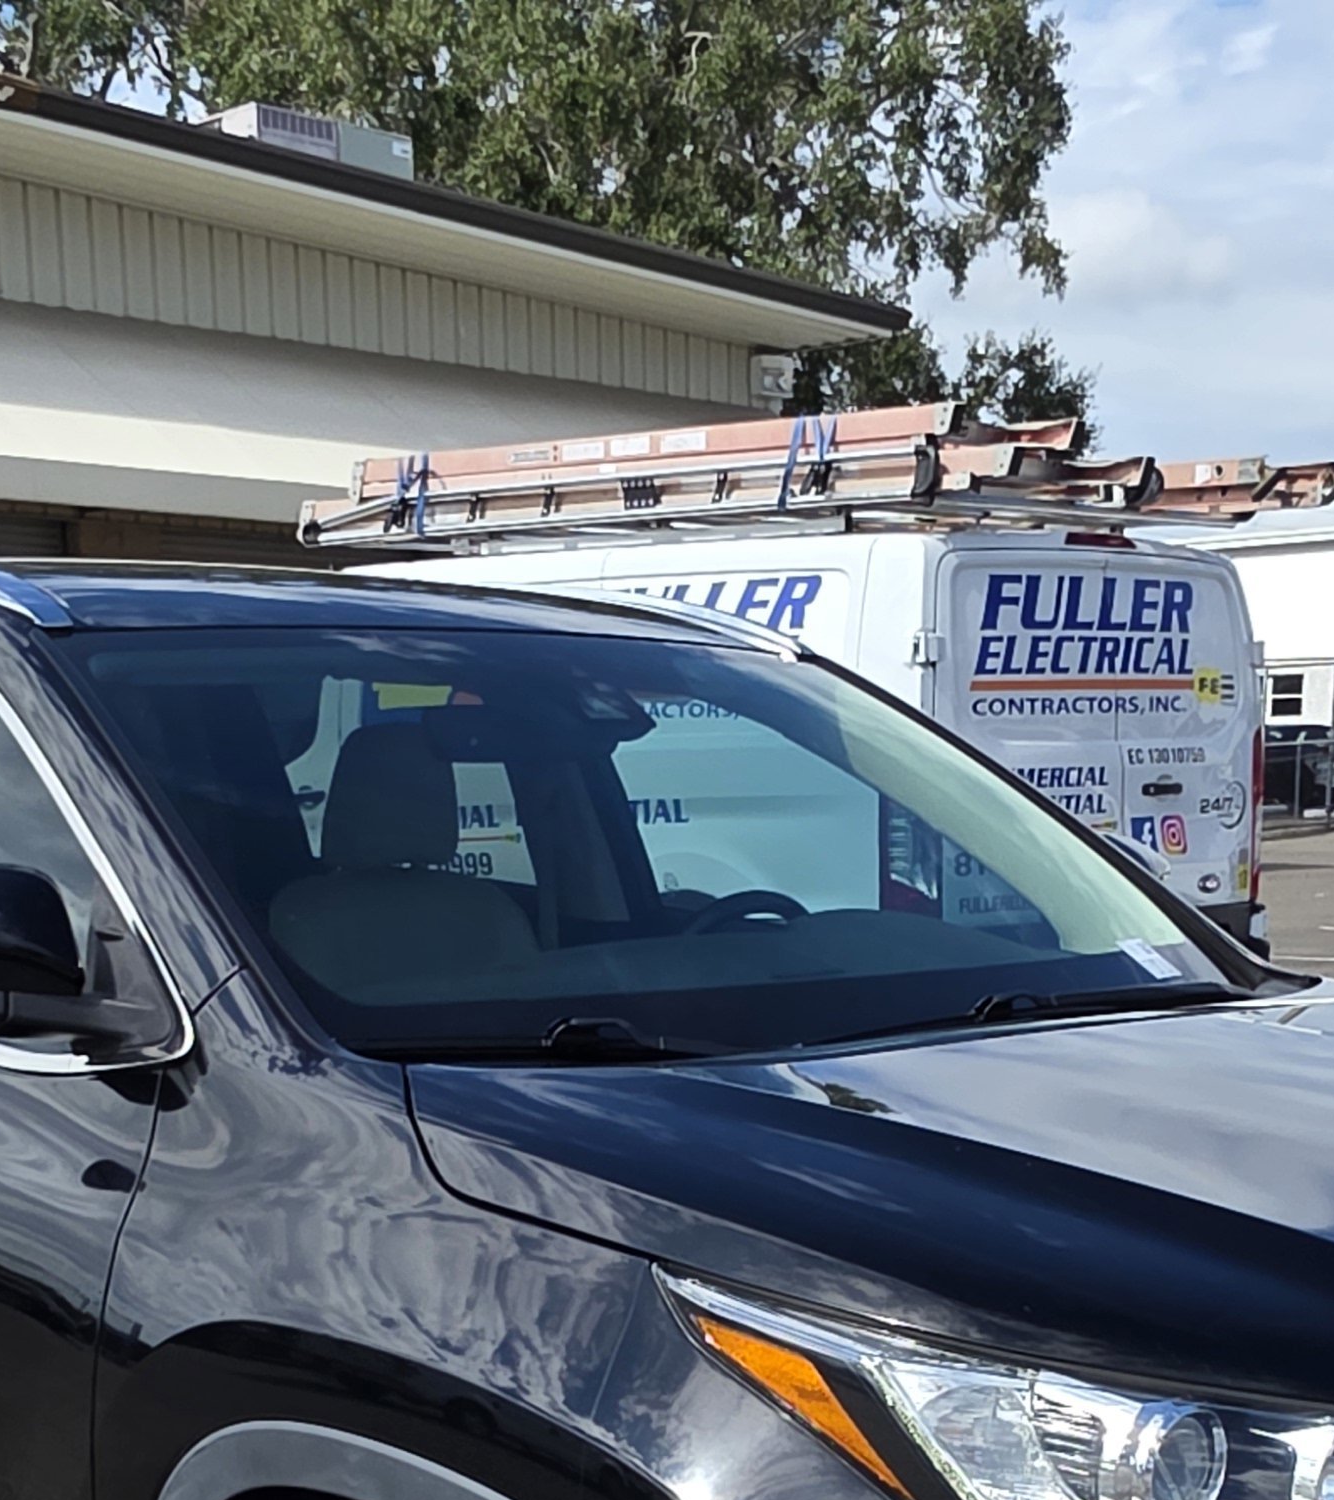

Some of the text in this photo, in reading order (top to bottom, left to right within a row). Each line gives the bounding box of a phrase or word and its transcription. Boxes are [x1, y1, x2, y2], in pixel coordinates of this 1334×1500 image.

[980, 574, 1193, 633] FULLER
[974, 635, 1194, 675] ELECTRICAL
[971, 696, 1187, 716] CONTRACTORS, INC.
[1127, 748, 1145, 765] EC
[1013, 766, 1109, 788] MERCIAL
